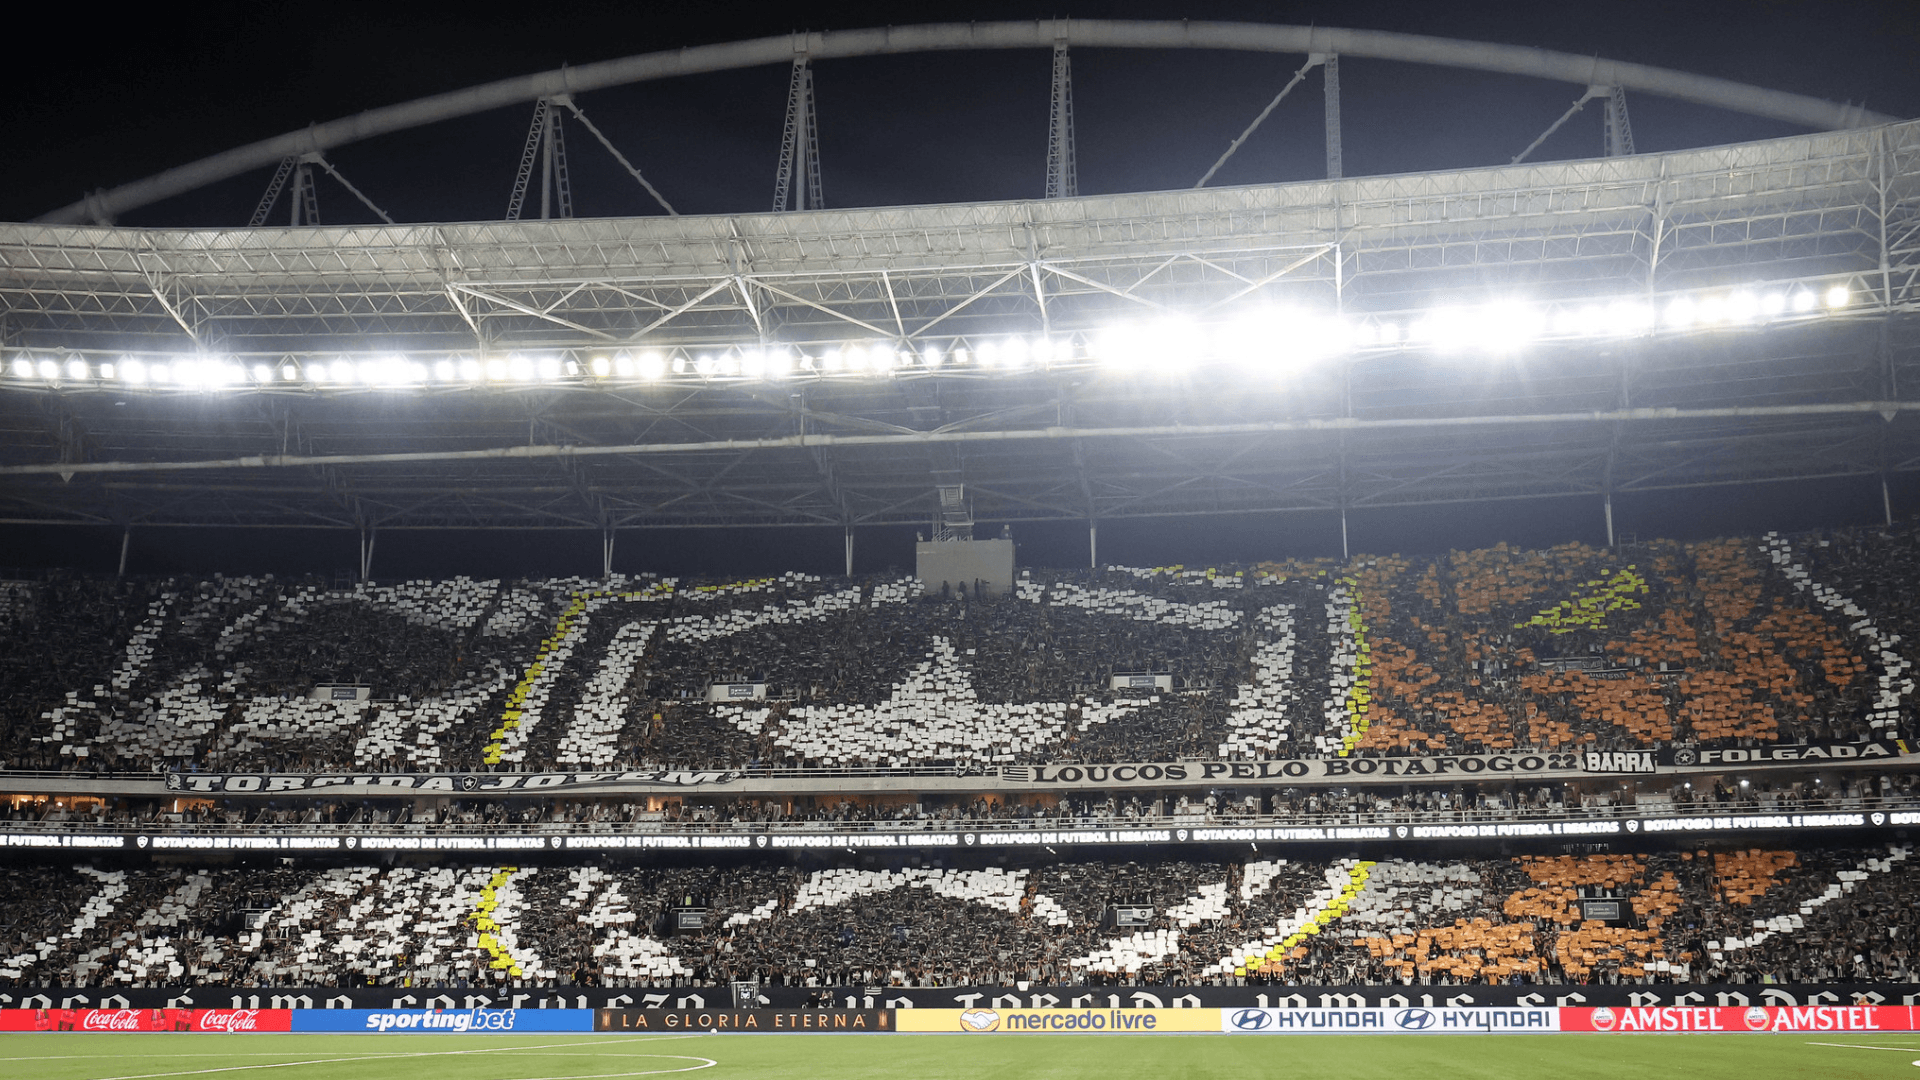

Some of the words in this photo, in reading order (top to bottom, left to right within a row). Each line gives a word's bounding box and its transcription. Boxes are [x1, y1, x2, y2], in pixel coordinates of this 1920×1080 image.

[1585, 751, 1655, 773] BARRA
[1700, 743, 1890, 764] FOLGADA
[1032, 764, 1188, 783] LOUCOS
[1200, 761, 1310, 779] PELO
[1322, 755, 1545, 777] BOTAFOGO
[479, 771, 728, 790] JOVEM
[1413, 826, 1478, 837] BOTAFOGO
[1479, 825, 1496, 836] DE
[1497, 824, 1552, 835] FUTEBOL
[1553, 824, 1561, 834] E
[1562, 822, 1619, 834] REGATAS
[1644, 819, 1713, 831] BOTAFOGO
[1714, 818, 1732, 829] DE
[1733, 817, 1791, 829] FUTEBOL
[1792, 817, 1802, 827] E
[1803, 815, 1864, 827] REGATAS
[9, 835, 61, 847] FUTEBOL
[153, 837, 213, 848] BOTAFOGO
[214, 837, 229, 848] DE
[230, 837, 280, 848] FUTEBOL
[281, 837, 289, 848] E
[290, 837, 340, 848] REGATAS
[566, 836, 625, 848] BOTAFOGO
[626, 836, 641, 847] DE
[642, 836, 691, 847] FUTEBOL
[692, 836, 700, 847] E
[701, 836, 750, 847] REGATAS
[772, 835, 831, 847] BOTAFOGO
[832, 835, 848, 846] DE
[849, 835, 898, 846] FUTEBOL
[899, 835, 907, 846] E
[908, 834, 958, 846] REGATAS
[980, 833, 1041, 844] BOTAFOGO
[1042, 833, 1057, 844] DE
[1058, 832, 1109, 843] FUTEBOL
[1110, 832, 1118, 842] E
[1119, 831, 1170, 842] REGATAS
[1193, 830, 1255, 840] BOTAFOGO
[1257, 829, 1272, 840] DE
[1273, 828, 1325, 839] FUTEBOL
[1327, 828, 1335, 838] E
[1336, 828, 1390, 838] REGATAS
[361, 838, 420, 848] BOTAFOGO
[421, 838, 436, 848] DE
[437, 838, 486, 848] FUTEBOL
[487, 838, 495, 848] E
[496, 838, 545, 848] REGATAS
[83, 1009, 142, 1030] Coca-Cola
[200, 1009, 260, 1030] Coca-Cola
[366, 1009, 516, 1031] sportingbet
[622, 1013, 648, 1028] LA
[664, 1013, 758, 1028] GLORIA
[775, 1013, 866, 1028] ETERNA
[1006, 1010, 1106, 1030] mercado
[1110, 1010, 1157, 1030] livre
[1279, 1011, 1385, 1028] HYUNDAI
[1443, 1010, 1550, 1028] HYUNDAI
[1619, 1007, 1724, 1031] AMSTEL
[1774, 1006, 1880, 1030] AMSTEL
